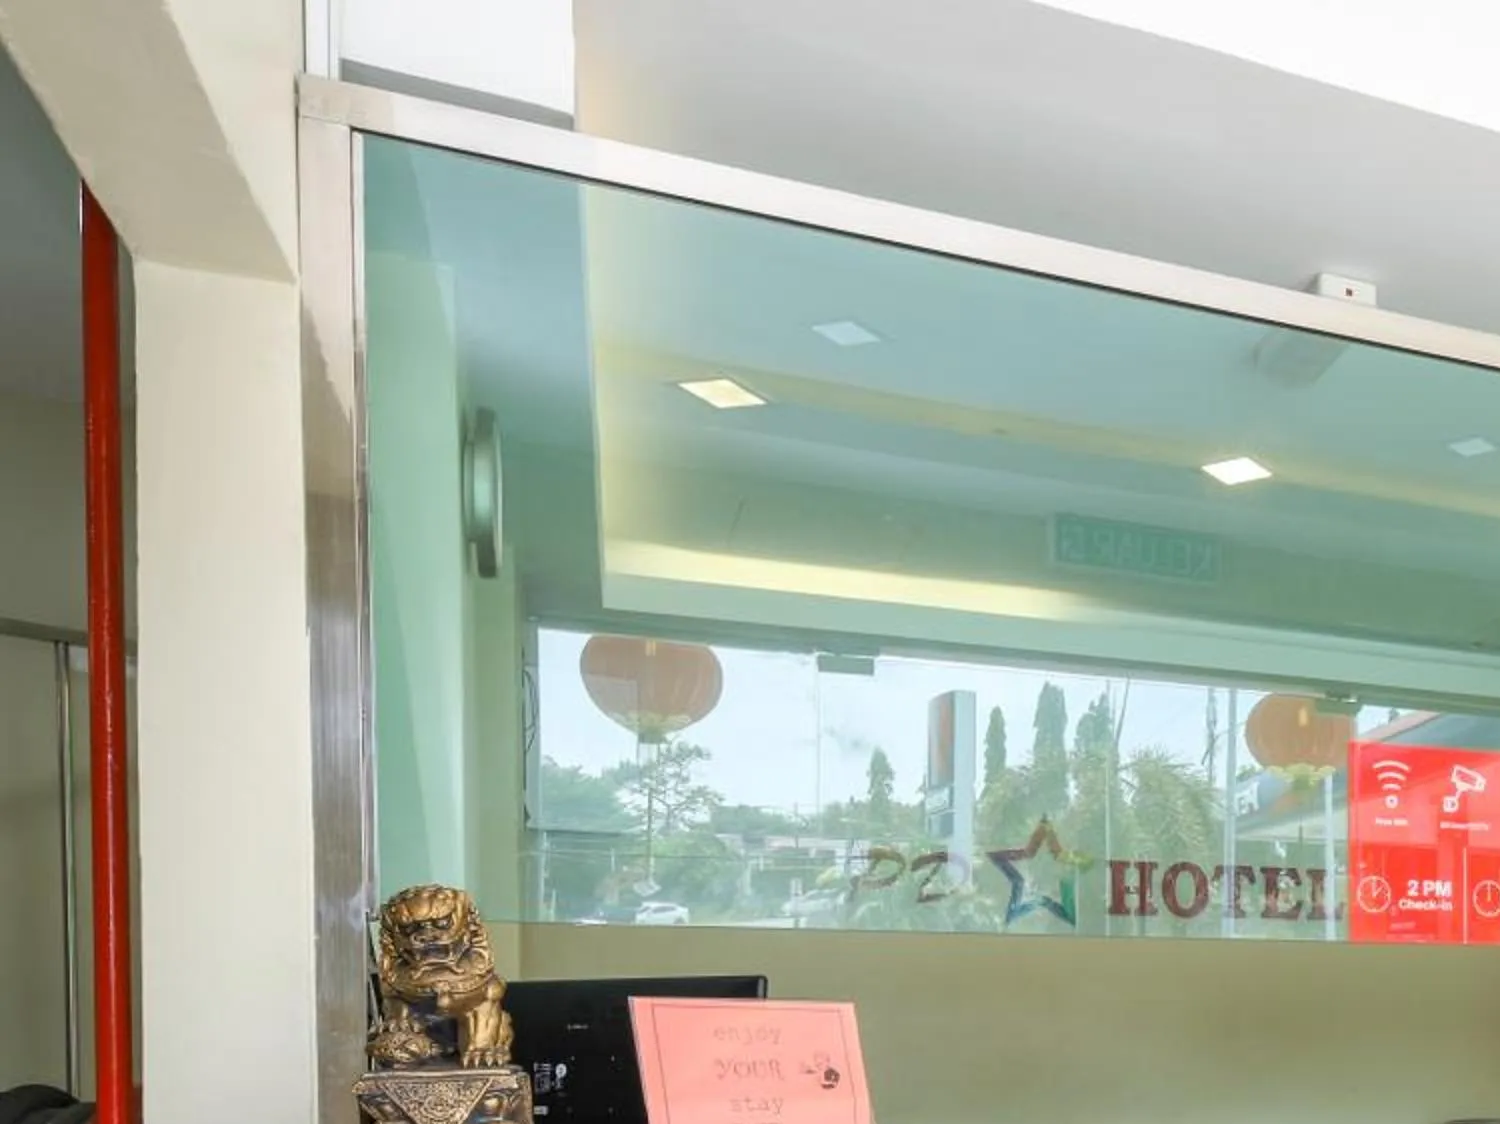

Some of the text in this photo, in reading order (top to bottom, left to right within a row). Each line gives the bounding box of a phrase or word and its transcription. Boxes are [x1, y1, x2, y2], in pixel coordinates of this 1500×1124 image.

[1105, 859, 1346, 922] HOTEL
[1407, 879, 1453, 897] 2 PM
